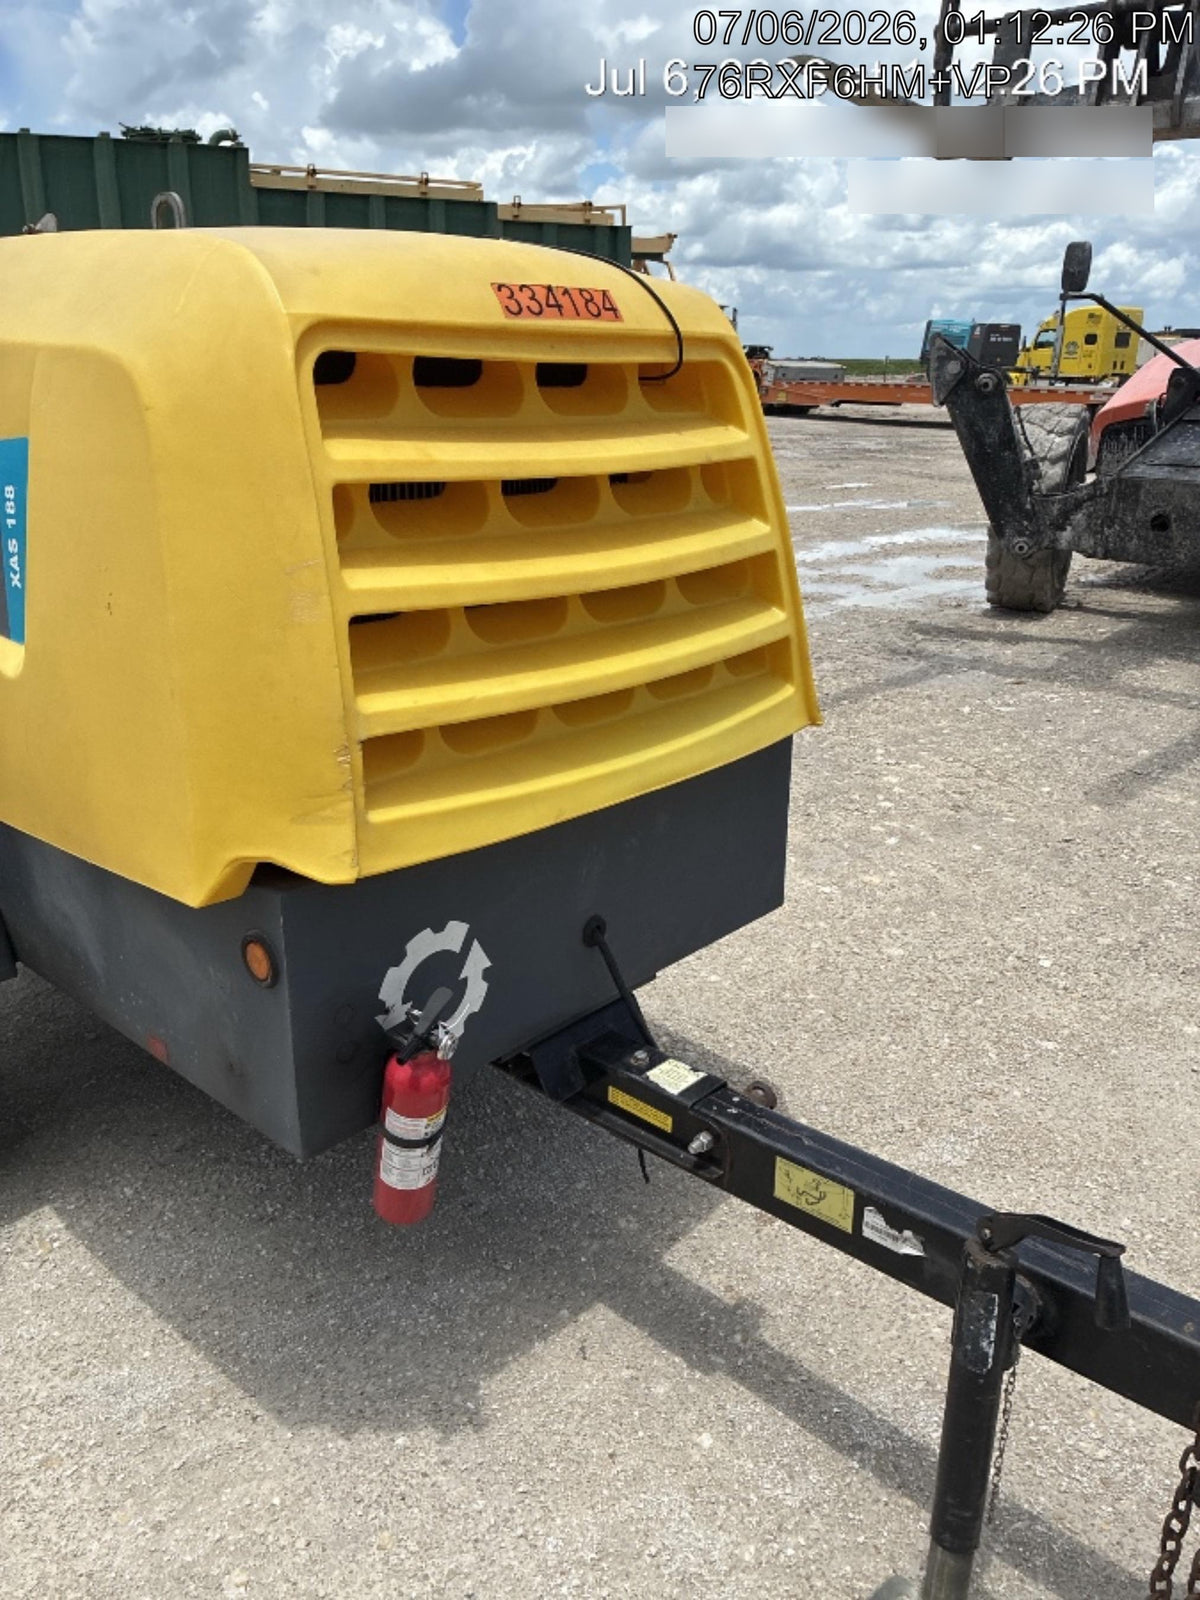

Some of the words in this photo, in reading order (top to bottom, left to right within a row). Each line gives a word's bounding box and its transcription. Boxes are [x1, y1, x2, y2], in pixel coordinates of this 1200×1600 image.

[496, 284, 620, 319] 334184
[4, 484, 17, 529] 188
[7, 538, 22, 589] XAS
